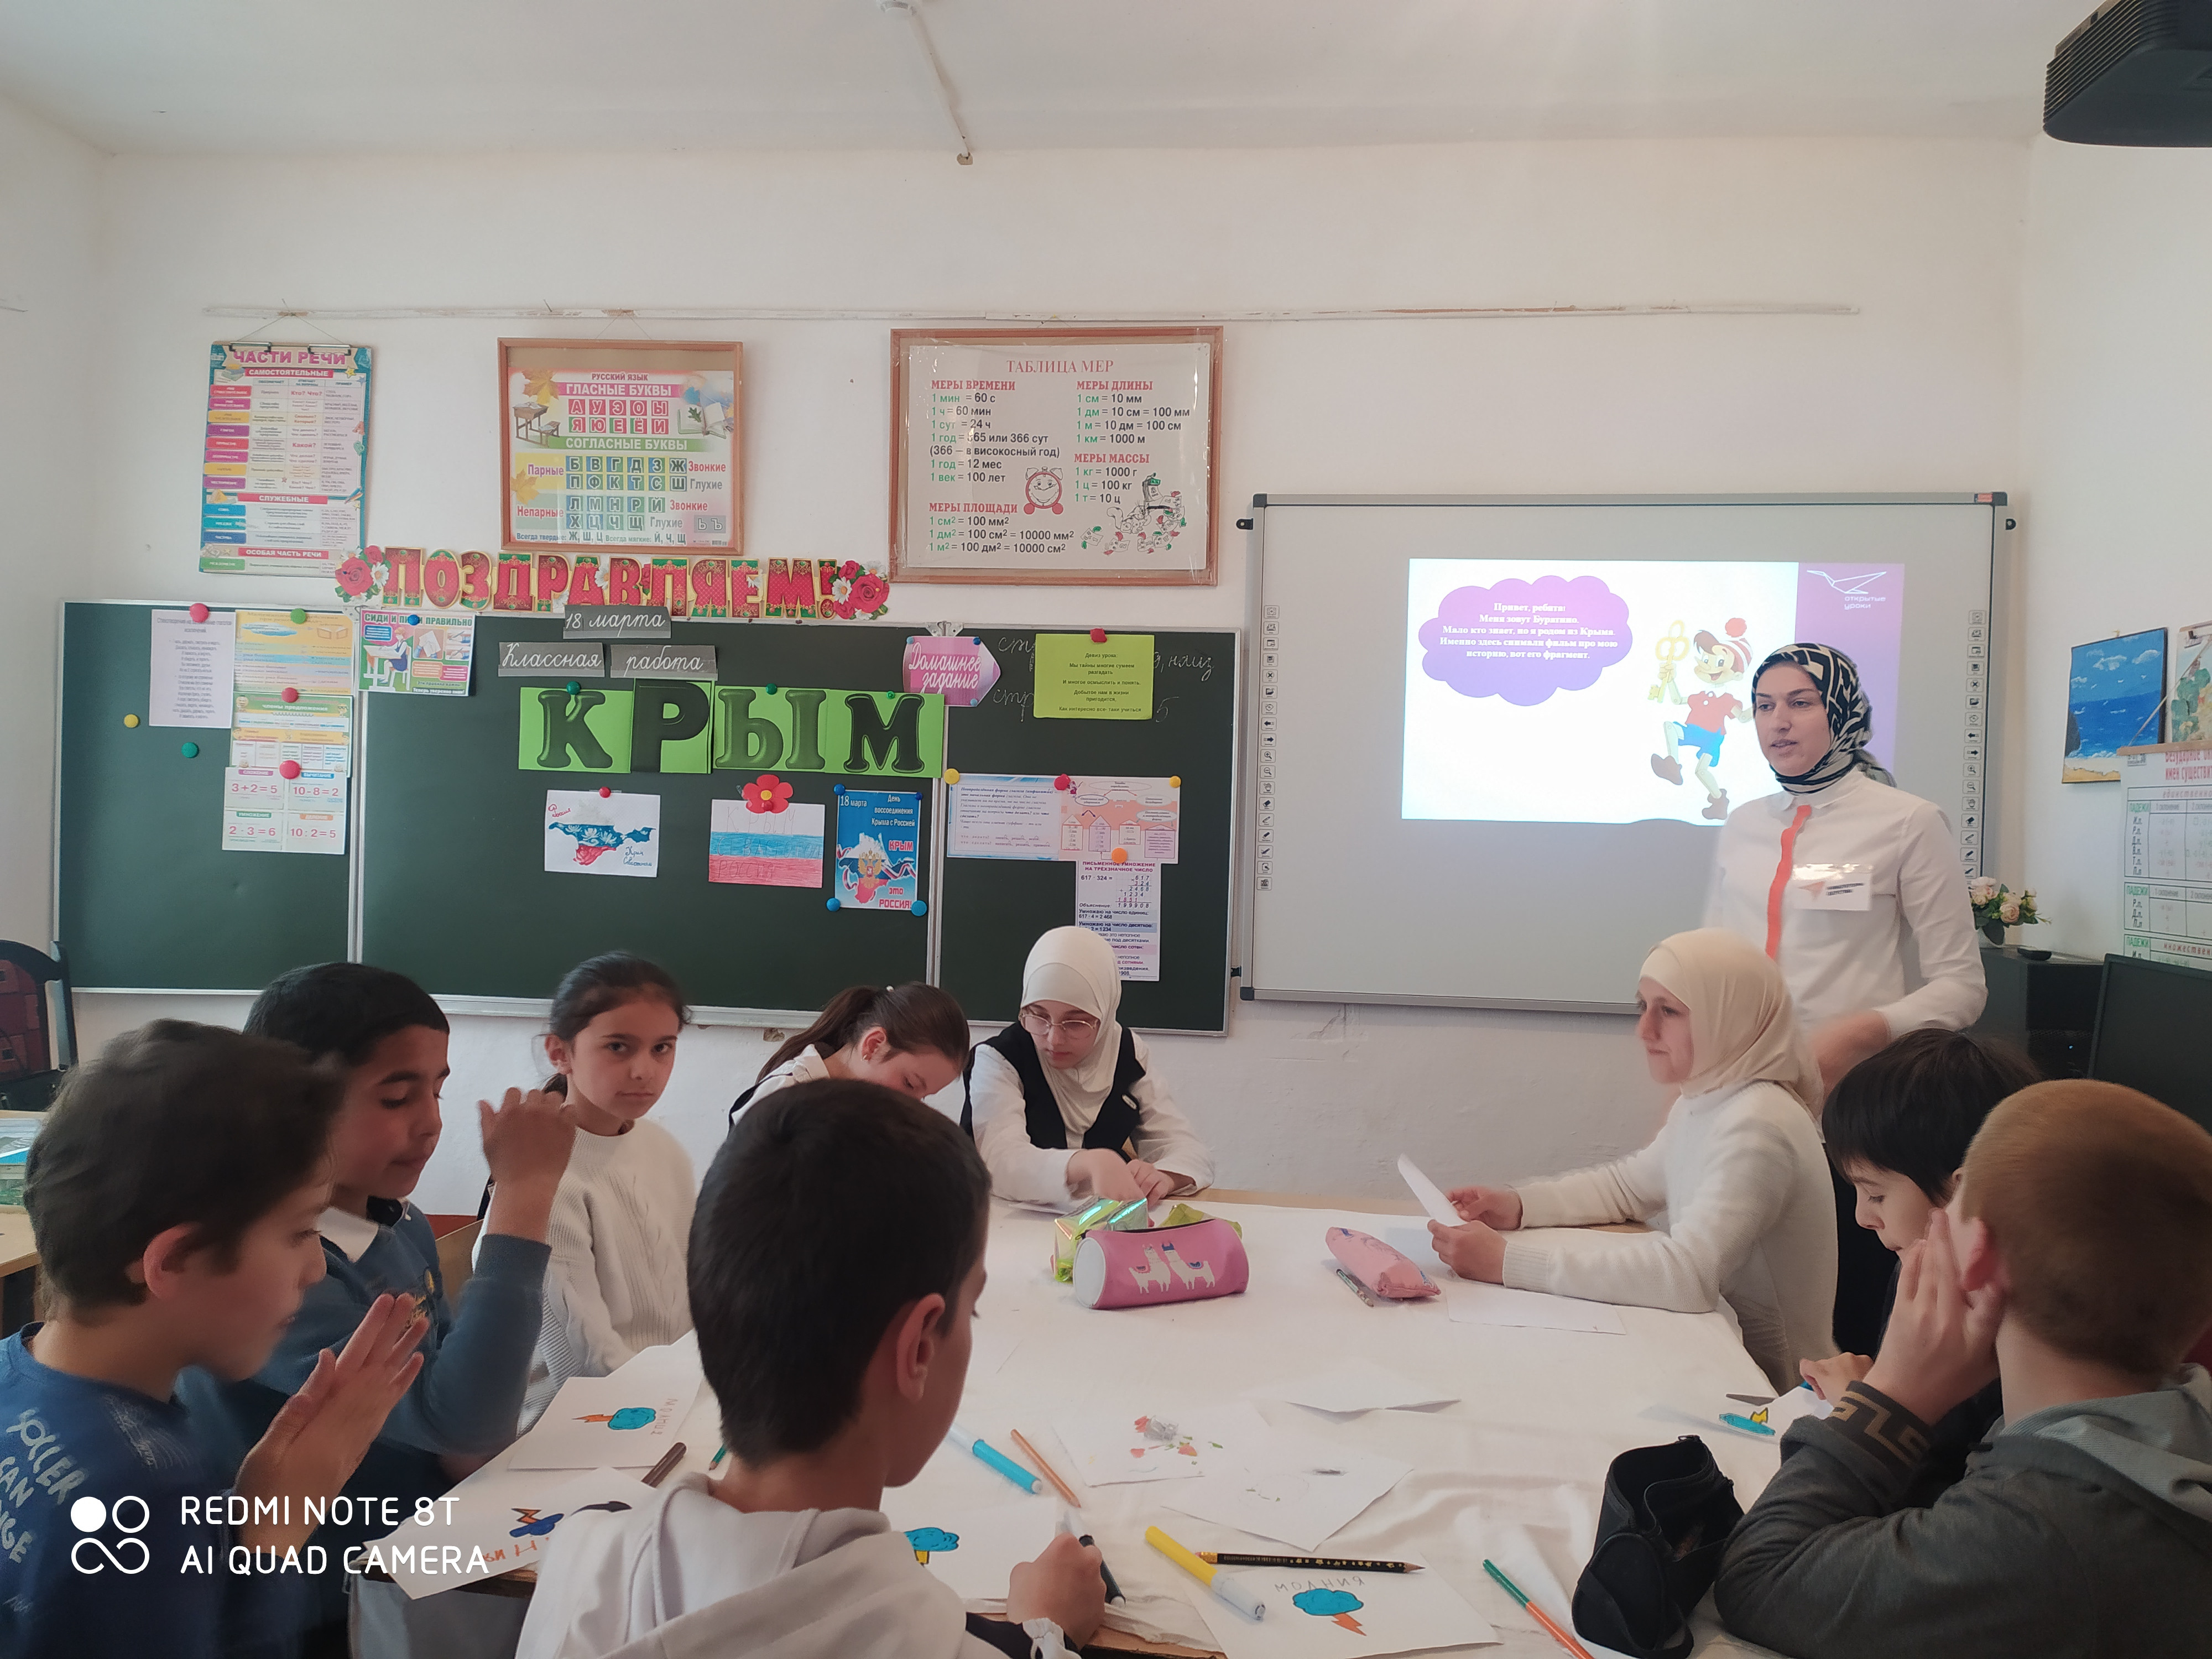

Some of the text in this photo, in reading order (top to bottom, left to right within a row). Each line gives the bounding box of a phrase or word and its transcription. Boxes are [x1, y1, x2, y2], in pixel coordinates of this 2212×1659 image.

[233, 351, 346, 364] ЧАСТИ РЕЧИ
[1006, 360, 1114, 374] ТАБЛИЦА МЕР
[592, 372, 625, 380] РУССКИЙ
[566, 384, 671, 396] ГЛАСНЫЕ БУКВЫ
[932, 380, 1015, 390] МЕРЫ ВРЕМЕНИ
[1077, 381, 1153, 392] МЕРЫ ДЛИНЫ
[566, 438, 687, 451] СОГЛАСНЫЕ БУКВЫ
[932, 433, 936, 442] 1
[939, 435, 957, 444] год
[1010, 434, 1029, 442] 366
[1032, 436, 1048, 445] сут
[1077, 434, 1081, 443] 1
[1110, 434, 1134, 444] 1000
[930, 445, 953, 457] (366
[974, 447, 1036, 456] високосный
[1039, 447, 1060, 458] год)
[1074, 453, 1150, 463] МЕРЫ МАССЫ
[528, 464, 564, 478] Парные
[688, 461, 726, 472] Звонкие
[690, 478, 722, 491] Глухие
[670, 500, 708, 510] Звонкие
[929, 503, 1018, 514] МЕРЫ ПЛОЩАДИ
[518, 506, 564, 519] Непарные
[650, 516, 683, 528] Глухие
[596, 532, 603, 542] Ц
[677, 534, 686, 545] Щ
[380, 546, 837, 619] ПОЗДРАВЛЯЕМ!
[1494, 603, 1531, 613] Привет,
[365, 614, 388, 623] СИДИ
[400, 616, 422, 624] ПИИ
[426, 617, 472, 626] ПРАВИЛЬНО
[565, 613, 666, 638] 18 марта
[1506, 617, 1531, 625] зовут
[1533, 615, 1579, 625] Буратино.
[1580, 627, 1615, 637] Крыма.
[1546, 639, 1577, 648] фильм
[502, 643, 703, 677] Классная работа
[909, 642, 981, 672] Домашнее
[1543, 650, 1590, 660] фрагмент.
[920, 672, 978, 694] задание
[536, 681, 925, 774] КРЫМ
[841, 795, 849, 806] 18
[872, 818, 889, 826] Крыма
[889, 841, 913, 851] КРЫМ
[879, 899, 912, 909] РОССИЯ!
